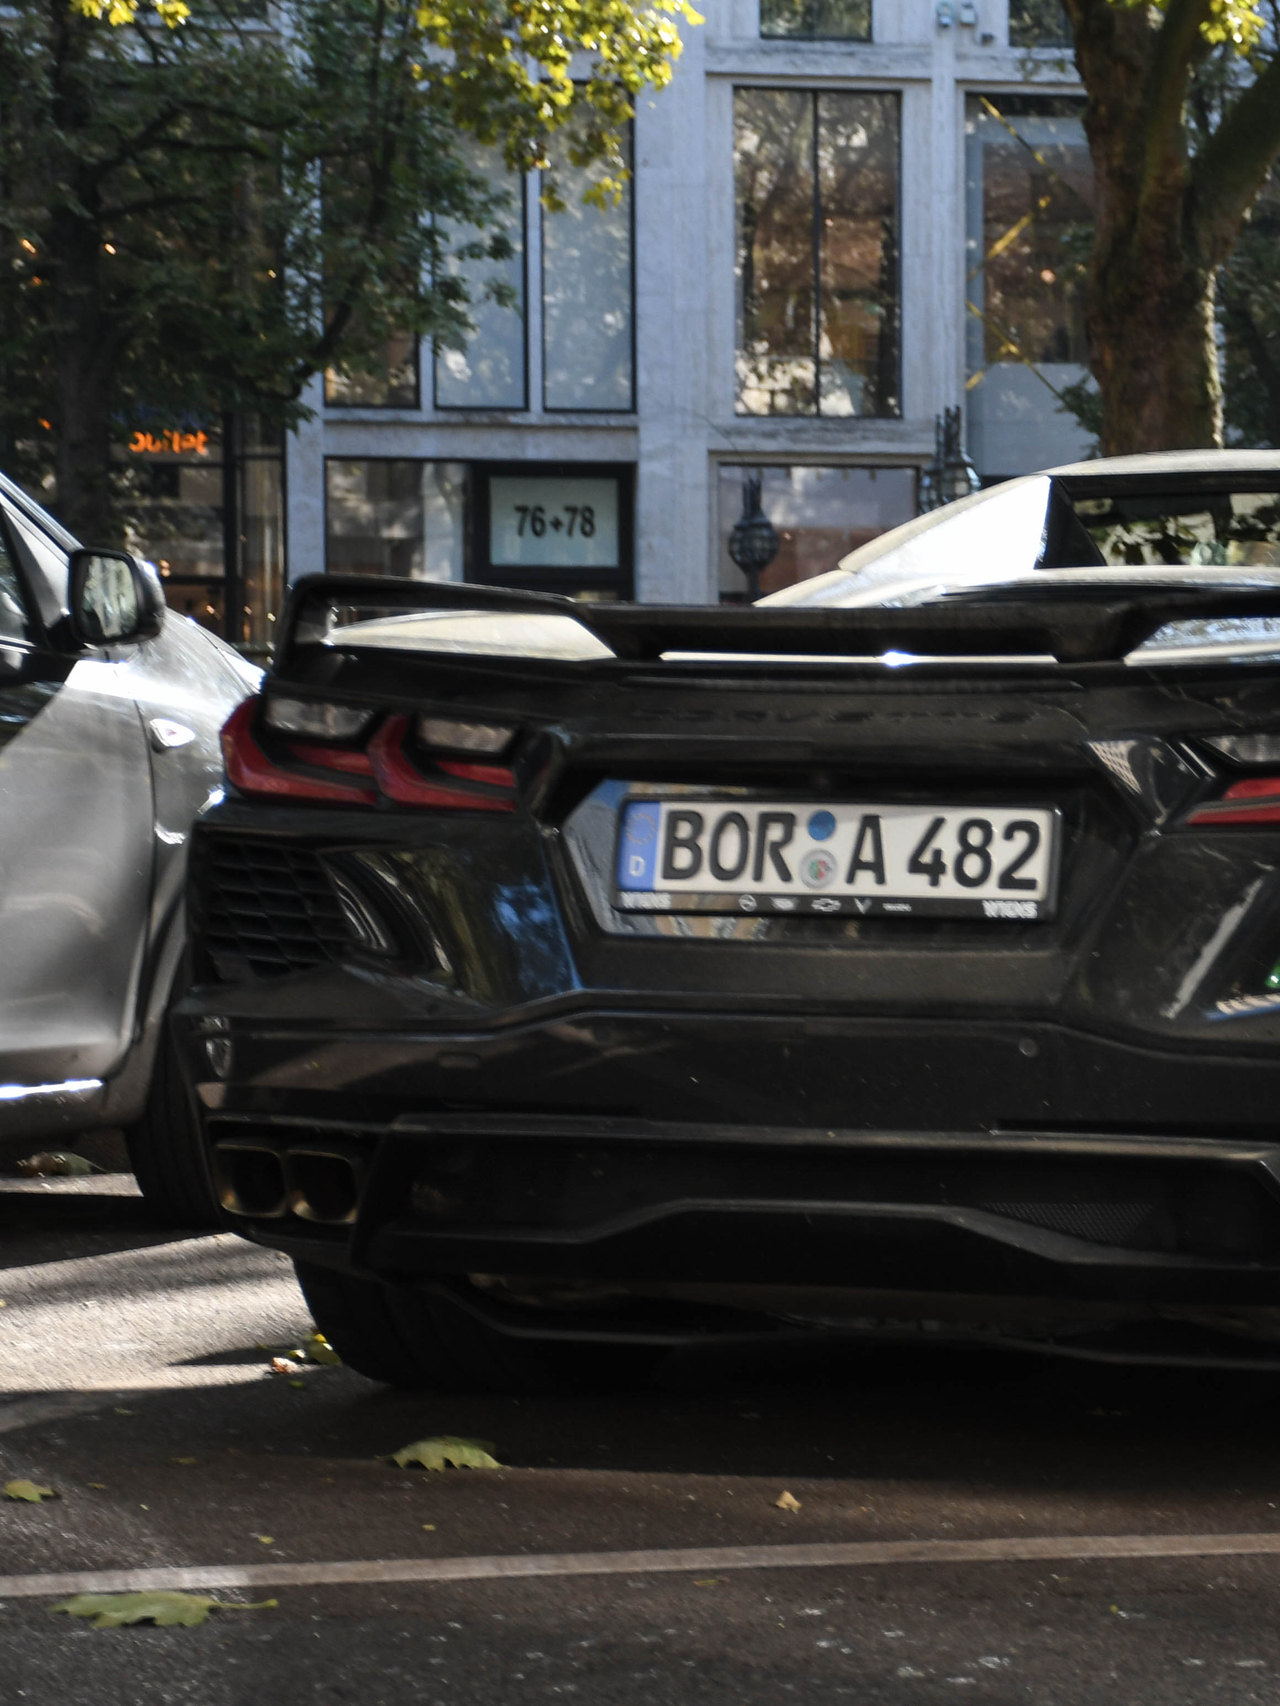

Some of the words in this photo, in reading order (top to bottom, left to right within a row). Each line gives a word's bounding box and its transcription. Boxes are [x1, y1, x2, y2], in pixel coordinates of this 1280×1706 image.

[629, 855, 646, 877] D
[662, 810, 796, 882] BOR
[846, 814, 886, 885] A
[908, 817, 1041, 890] 482
